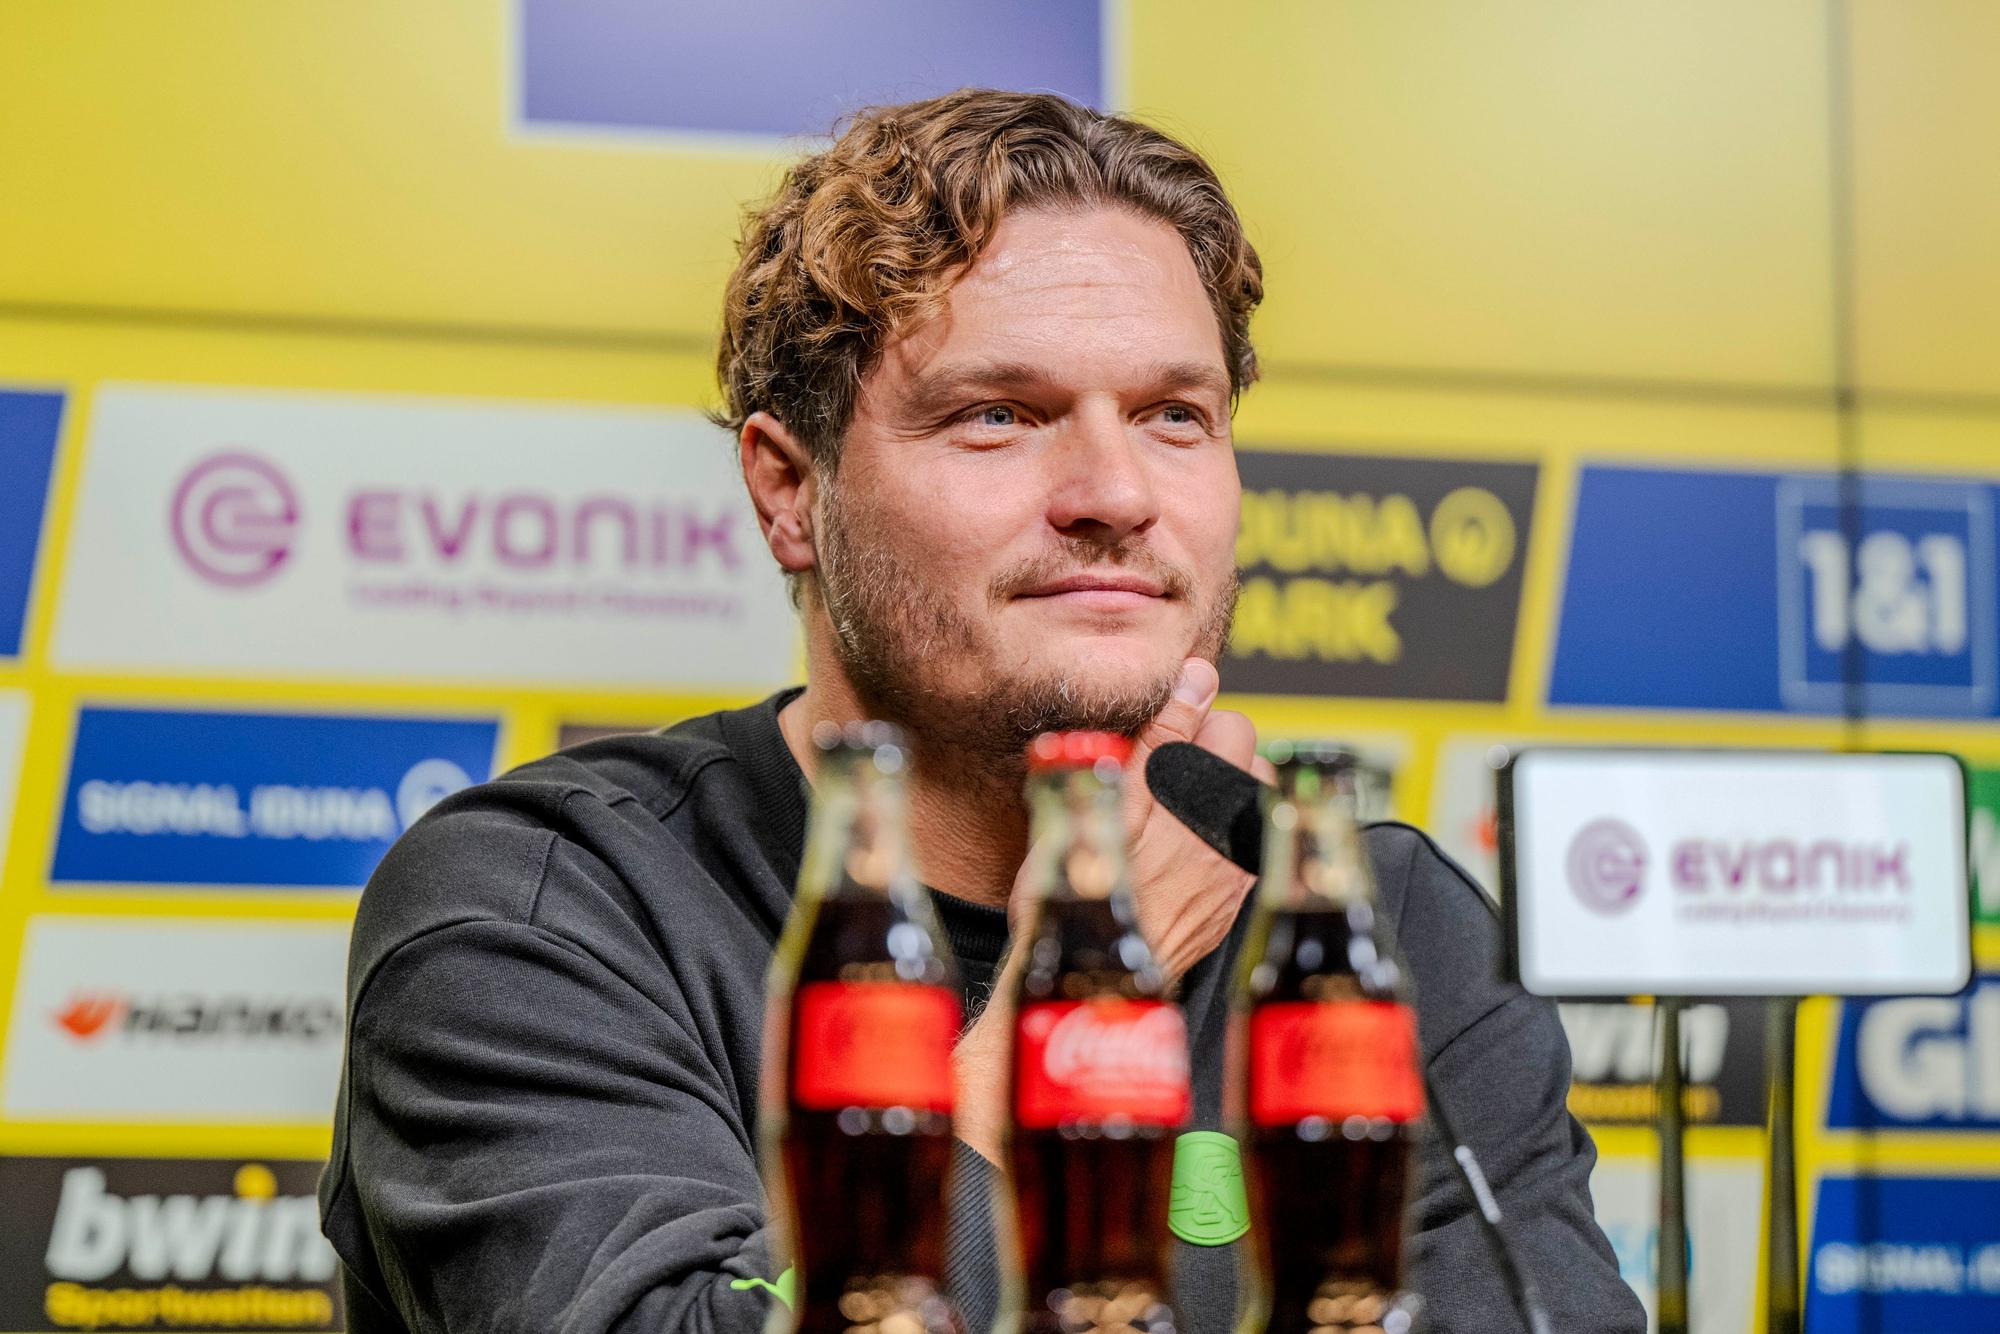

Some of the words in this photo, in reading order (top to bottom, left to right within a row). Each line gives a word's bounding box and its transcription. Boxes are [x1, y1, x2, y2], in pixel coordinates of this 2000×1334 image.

[346, 490, 742, 570] EVONIK
[1799, 530, 1967, 656] 1&1
[78, 780, 250, 838] SIGNAL
[250, 784, 397, 841] IDUNA
[1671, 840, 1913, 891] EVONIK
[45, 1163, 337, 1281] bwin
